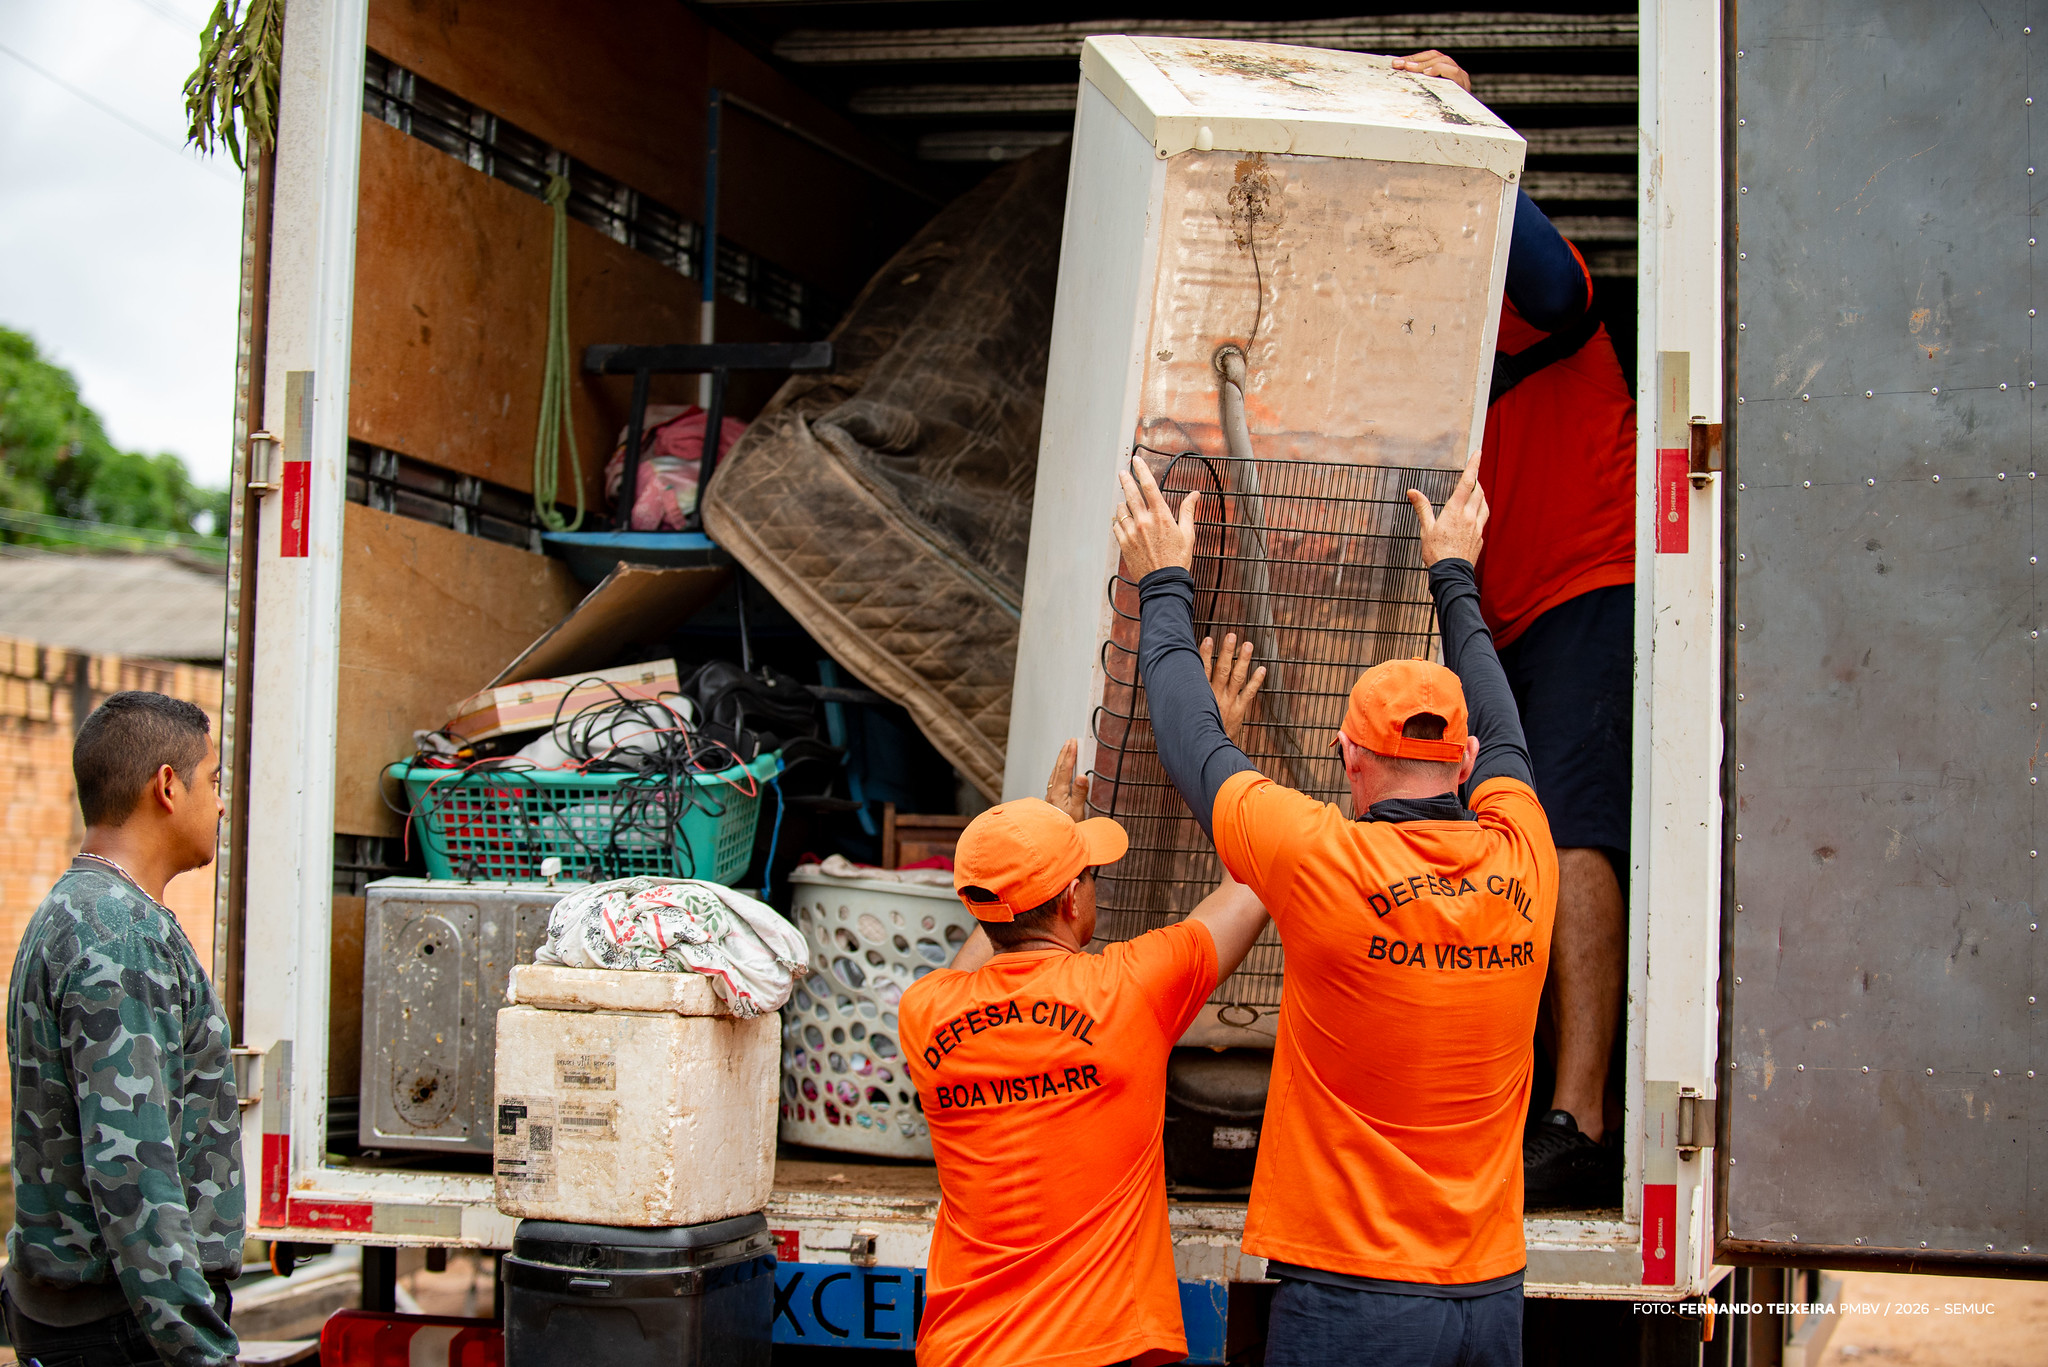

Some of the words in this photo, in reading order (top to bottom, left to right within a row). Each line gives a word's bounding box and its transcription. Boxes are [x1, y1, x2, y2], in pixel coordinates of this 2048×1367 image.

[1367, 874, 1478, 918] DEFESA
[1487, 874, 1533, 923] CIVIL
[1367, 935, 1426, 968] BOA
[1434, 941, 1535, 969] VISTA-RR
[923, 1000, 1023, 1070] DEFESA
[1032, 1001, 1095, 1046] CIVIL
[936, 1083, 986, 1109] BOA
[989, 1064, 1102, 1104] VISTA-RR
